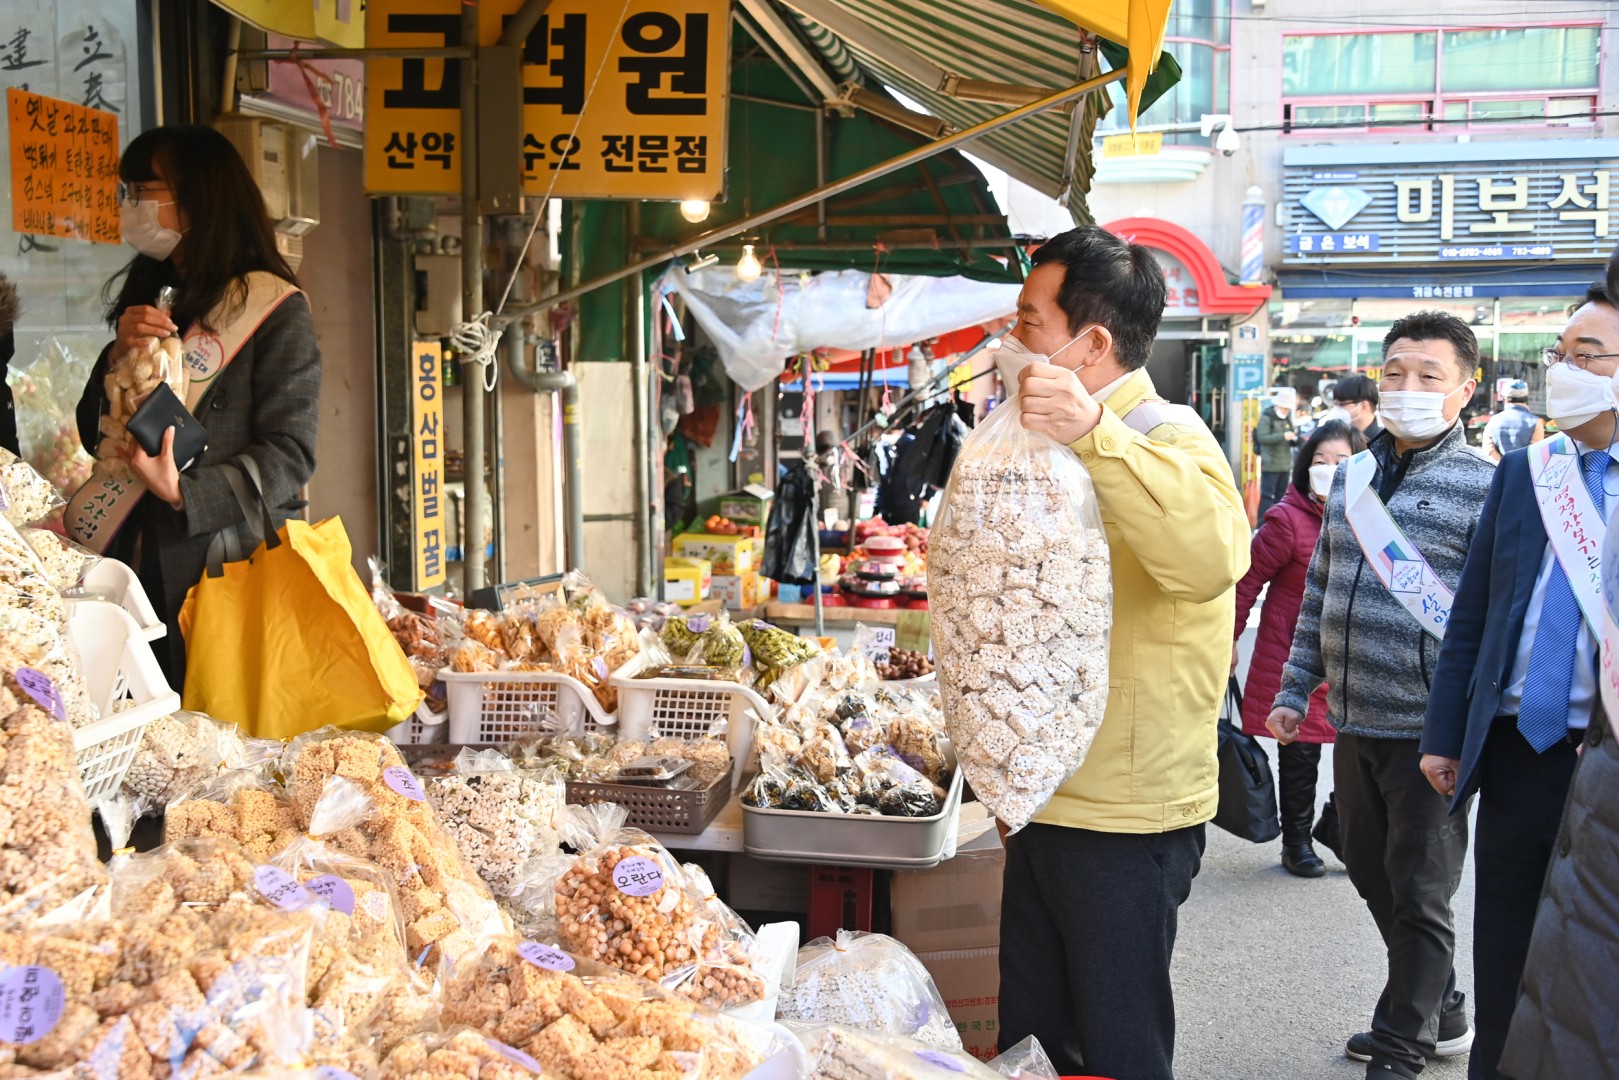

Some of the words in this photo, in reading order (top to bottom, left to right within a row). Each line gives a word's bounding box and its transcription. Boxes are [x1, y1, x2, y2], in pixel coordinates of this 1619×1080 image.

[26, 96, 59, 137] 옛날
[23, 141, 57, 171] 뻥튀기
[384, 132, 456, 170] 산약
[601, 135, 707, 173] 전문점
[1393, 168, 1610, 241] 미보석
[1320, 234, 1335, 250] 은
[1342, 234, 1370, 250] 보석
[1412, 286, 1473, 298] 귀금속전문점
[618, 870, 662, 888] 오란다
